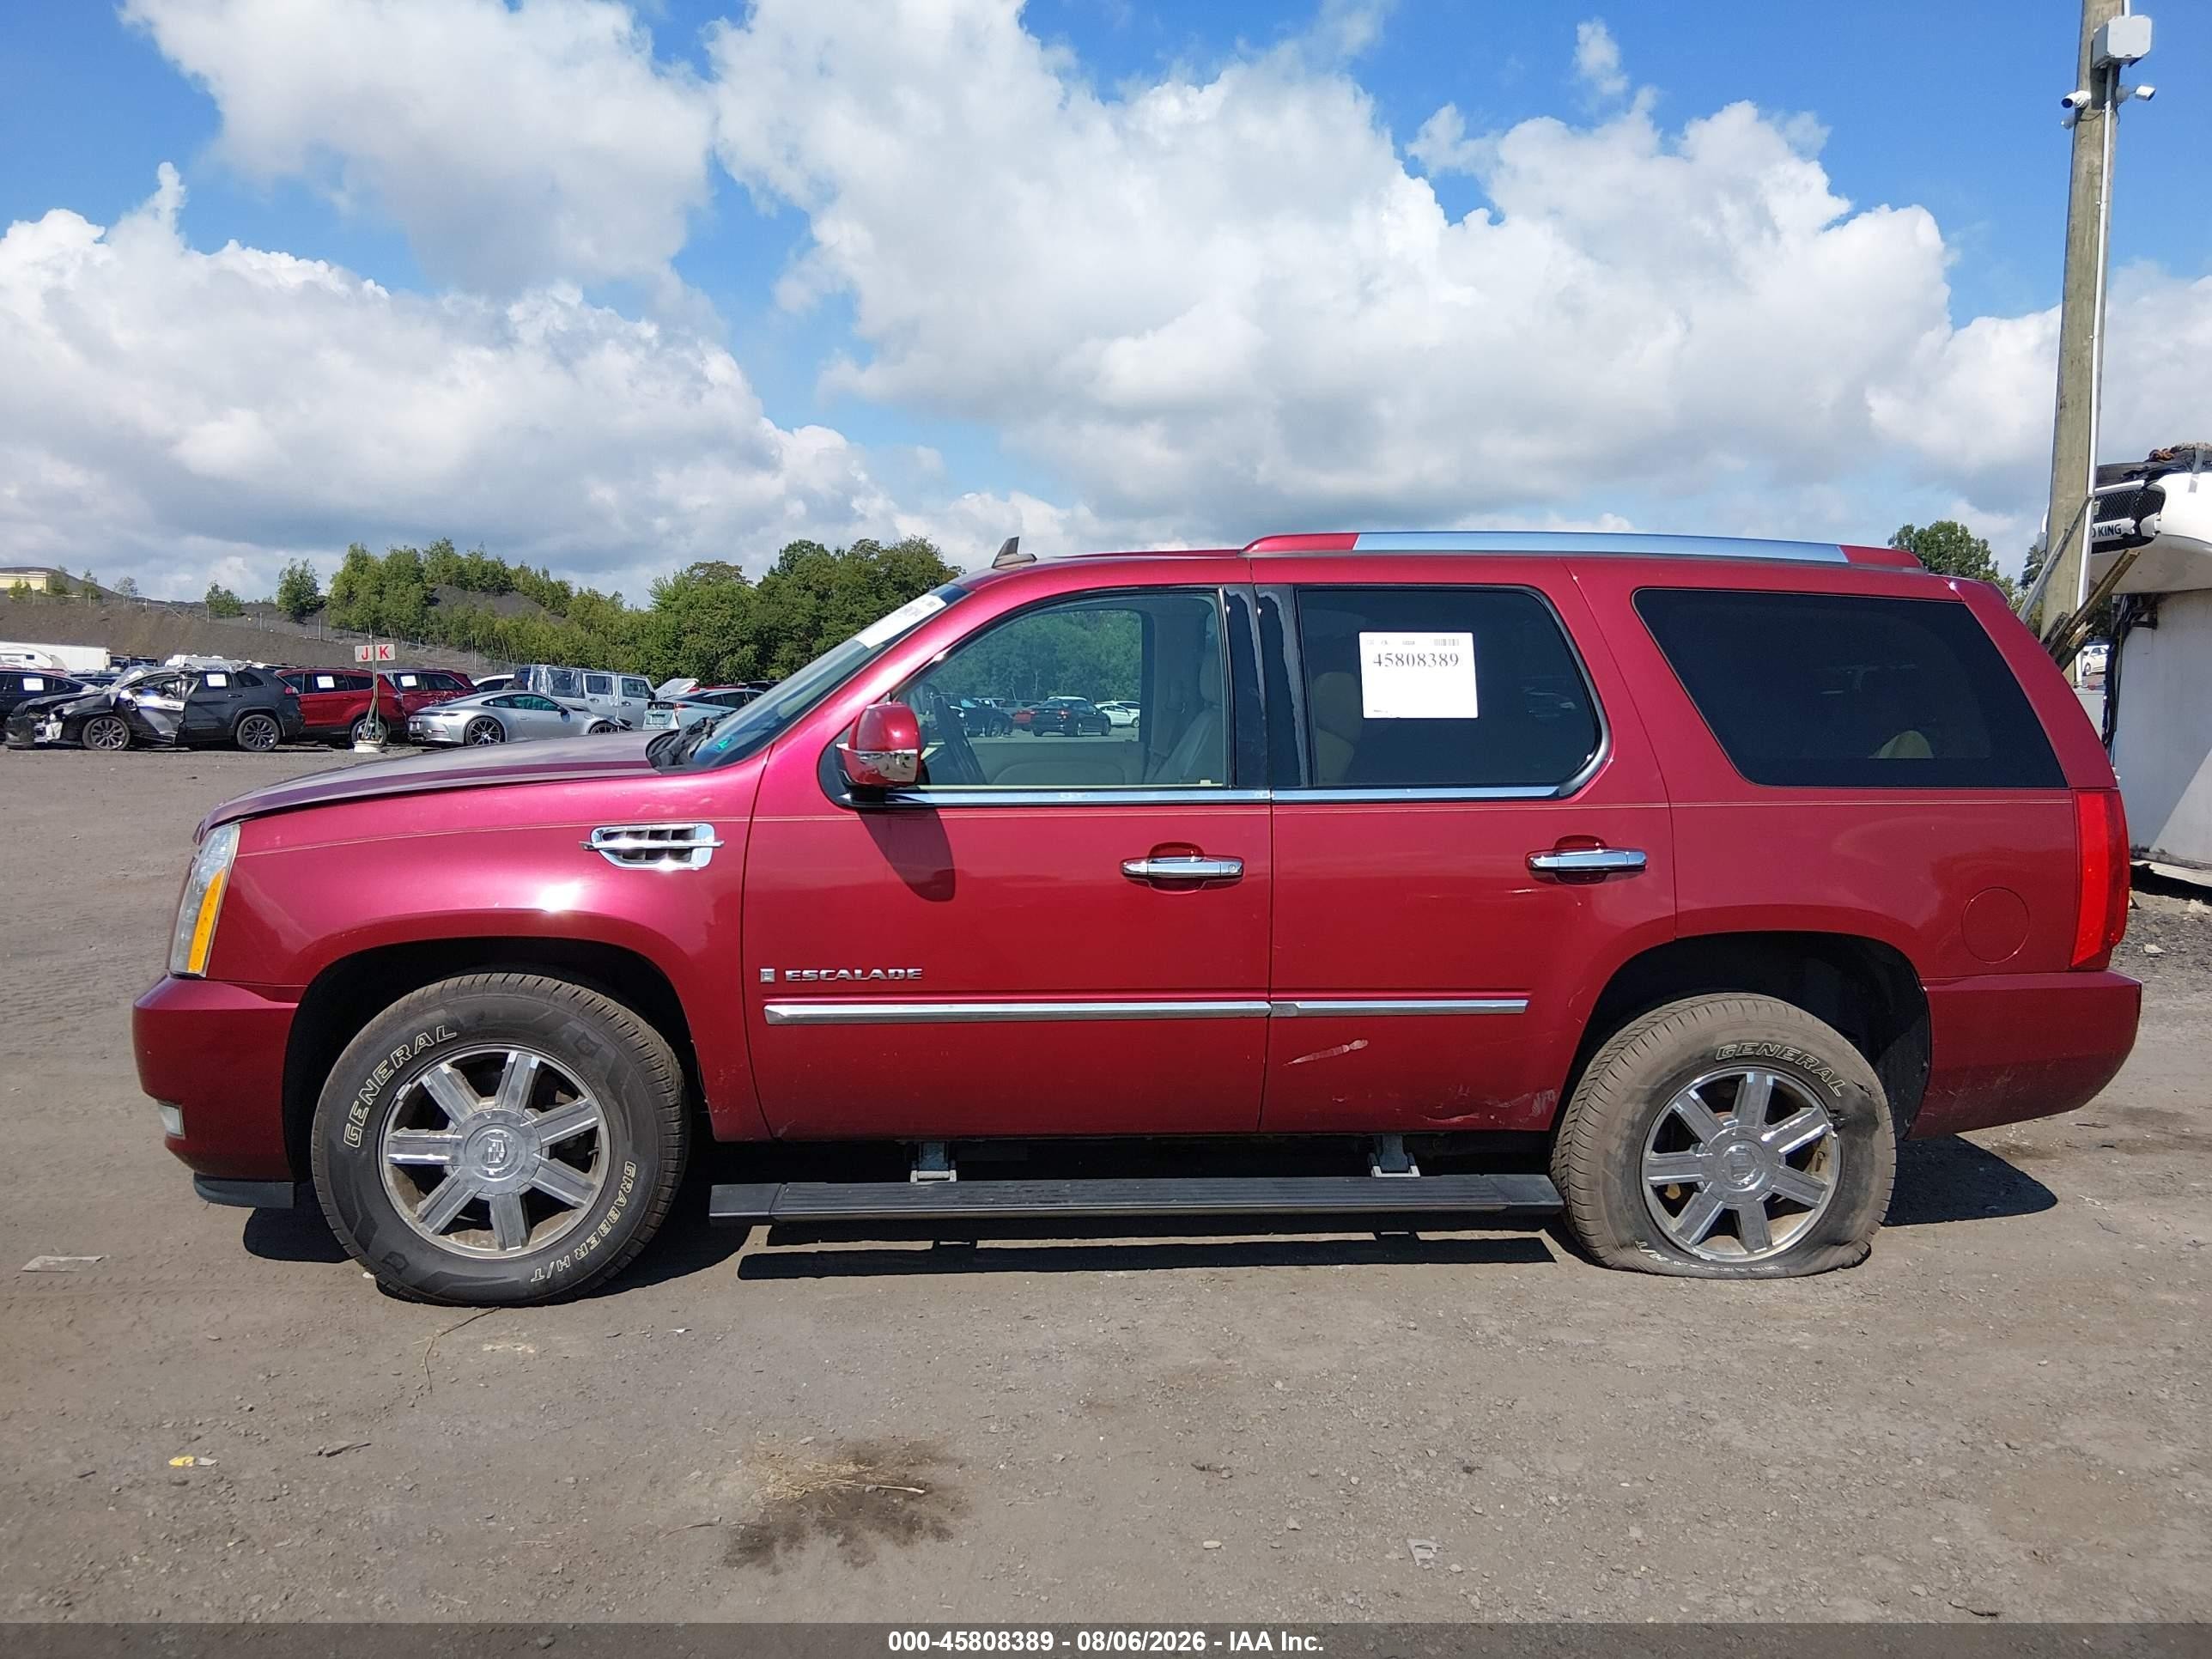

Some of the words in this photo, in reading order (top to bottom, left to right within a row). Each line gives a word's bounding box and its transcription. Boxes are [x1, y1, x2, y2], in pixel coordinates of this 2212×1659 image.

[2098, 524, 2122, 538] KING
[362, 647, 369, 660] J
[379, 645, 390, 659] K
[1373, 653, 1460, 667] 45808389
[785, 968, 923, 981] ESCALADE
[1716, 1042, 1846, 1097] GENERAL
[342, 1024, 459, 1149] GENERAL
[573, 1160, 637, 1261] GRABBER
[530, 1255, 571, 1283] H/T
